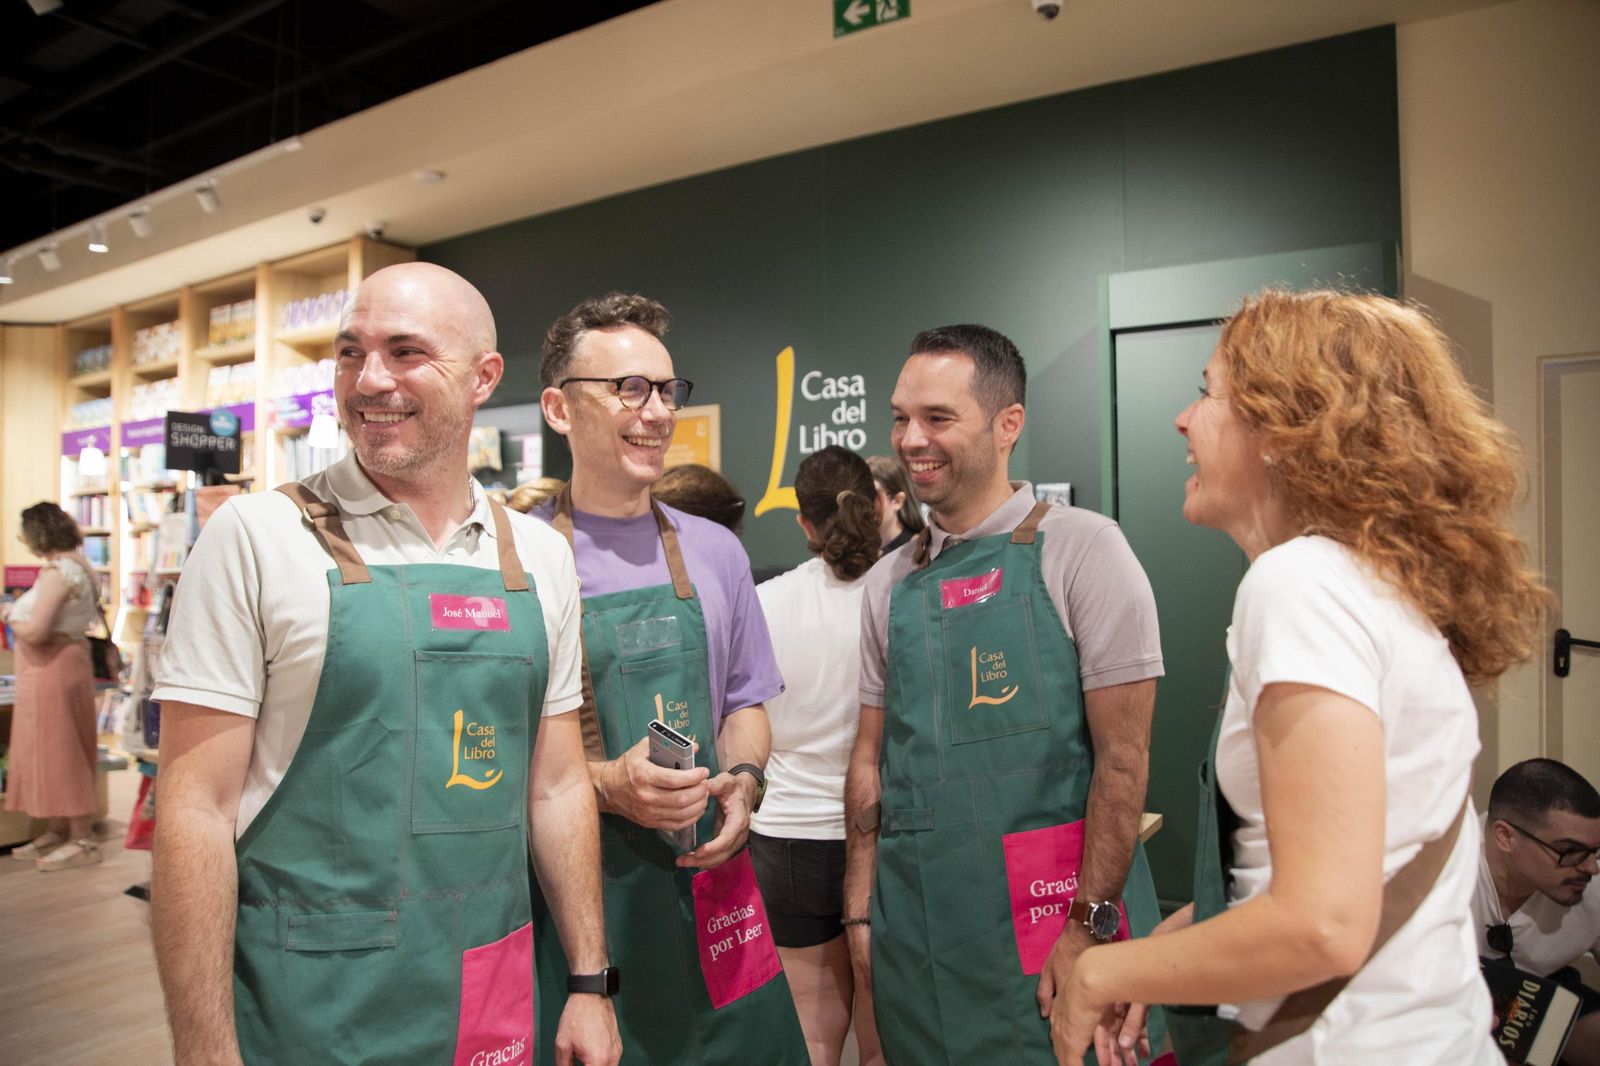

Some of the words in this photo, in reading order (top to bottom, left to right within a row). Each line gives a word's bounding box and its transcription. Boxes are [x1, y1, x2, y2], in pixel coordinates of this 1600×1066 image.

[801, 370, 866, 401] Casa
[832, 399, 866, 425] del
[170, 432, 237, 451] SHOPPER
[799, 422, 867, 453] Libro
[442, 606, 463, 618] José
[465, 607, 501, 619] Manuel
[979, 651, 1004, 664] Casa
[992, 660, 1006, 670] del
[980, 669, 1008, 683] Libro
[666, 701, 688, 712] Casa
[466, 722, 495, 737] Casa
[480, 736, 496, 748] del
[463, 746, 496, 760] Libro
[1030, 871, 1079, 898] Graci
[707, 904, 756, 934] Gracias
[1029, 902, 1063, 924] por
[709, 936, 734, 962] por
[734, 923, 763, 945] Leer
[1499, 979, 1541, 1049] DIARIOS
[470, 1037, 526, 1066] Gracias
